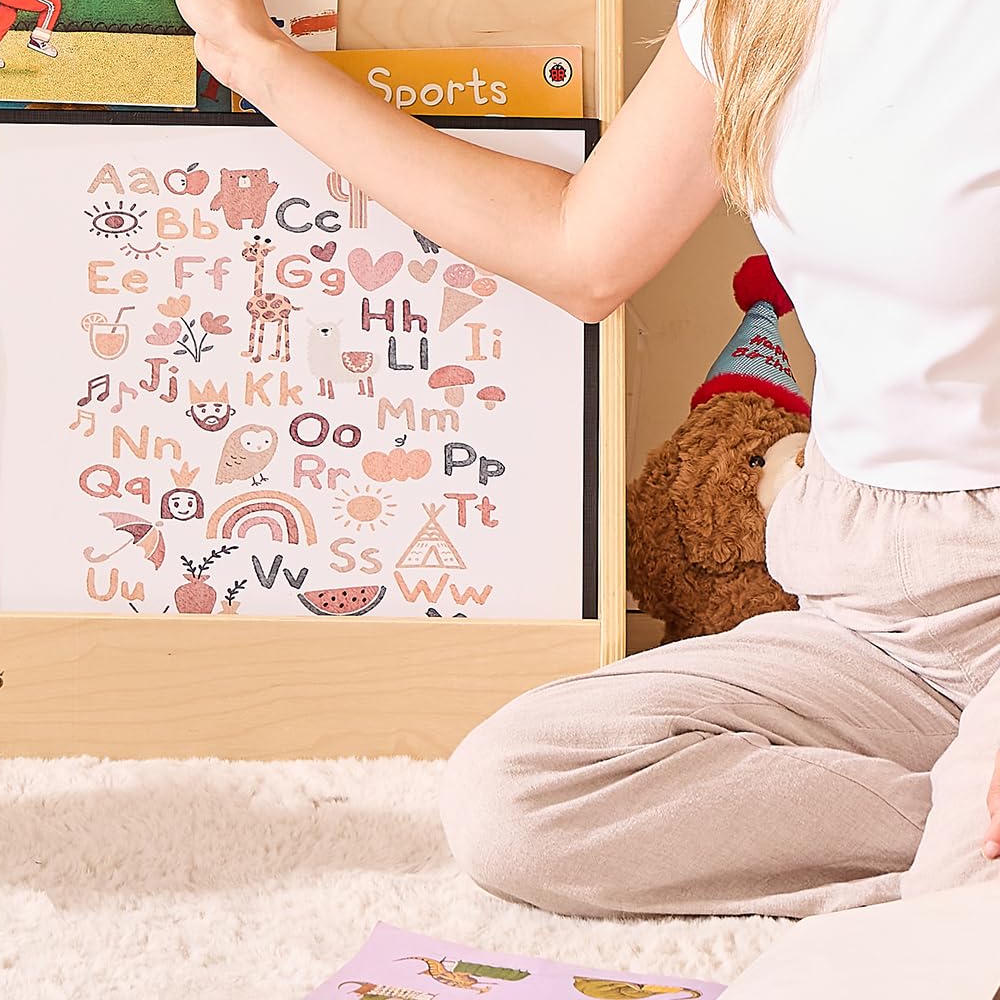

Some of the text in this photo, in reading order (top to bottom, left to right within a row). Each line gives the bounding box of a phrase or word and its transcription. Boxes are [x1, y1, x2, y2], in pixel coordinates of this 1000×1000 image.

[367, 66, 509, 110] Sports
[86, 162, 160, 196] Aa
[156, 206, 220, 240] Bb
[275, 197, 342, 233] Cc
[88, 260, 149, 295] Ee
[173, 255, 232, 291] Ff
[276, 254, 346, 296] Gg
[361, 297, 428, 334] Hh
[463, 322, 504, 361] Ii
[139, 357, 178, 403] Jj
[244, 370, 304, 407] Kk
[289, 411, 362, 448] Oo
[376, 396, 460, 433] Mm
[111, 424, 183, 461] Nn
[292, 453, 352, 490] Rr
[443, 442, 506, 486] Pp
[78, 464, 152, 505] Qq
[442, 492, 499, 528] Tt
[251, 554, 309, 590] Vv
[329, 537, 383, 575] Ss
[86, 566, 145, 602] Uu
[393, 570, 494, 606] Ww
